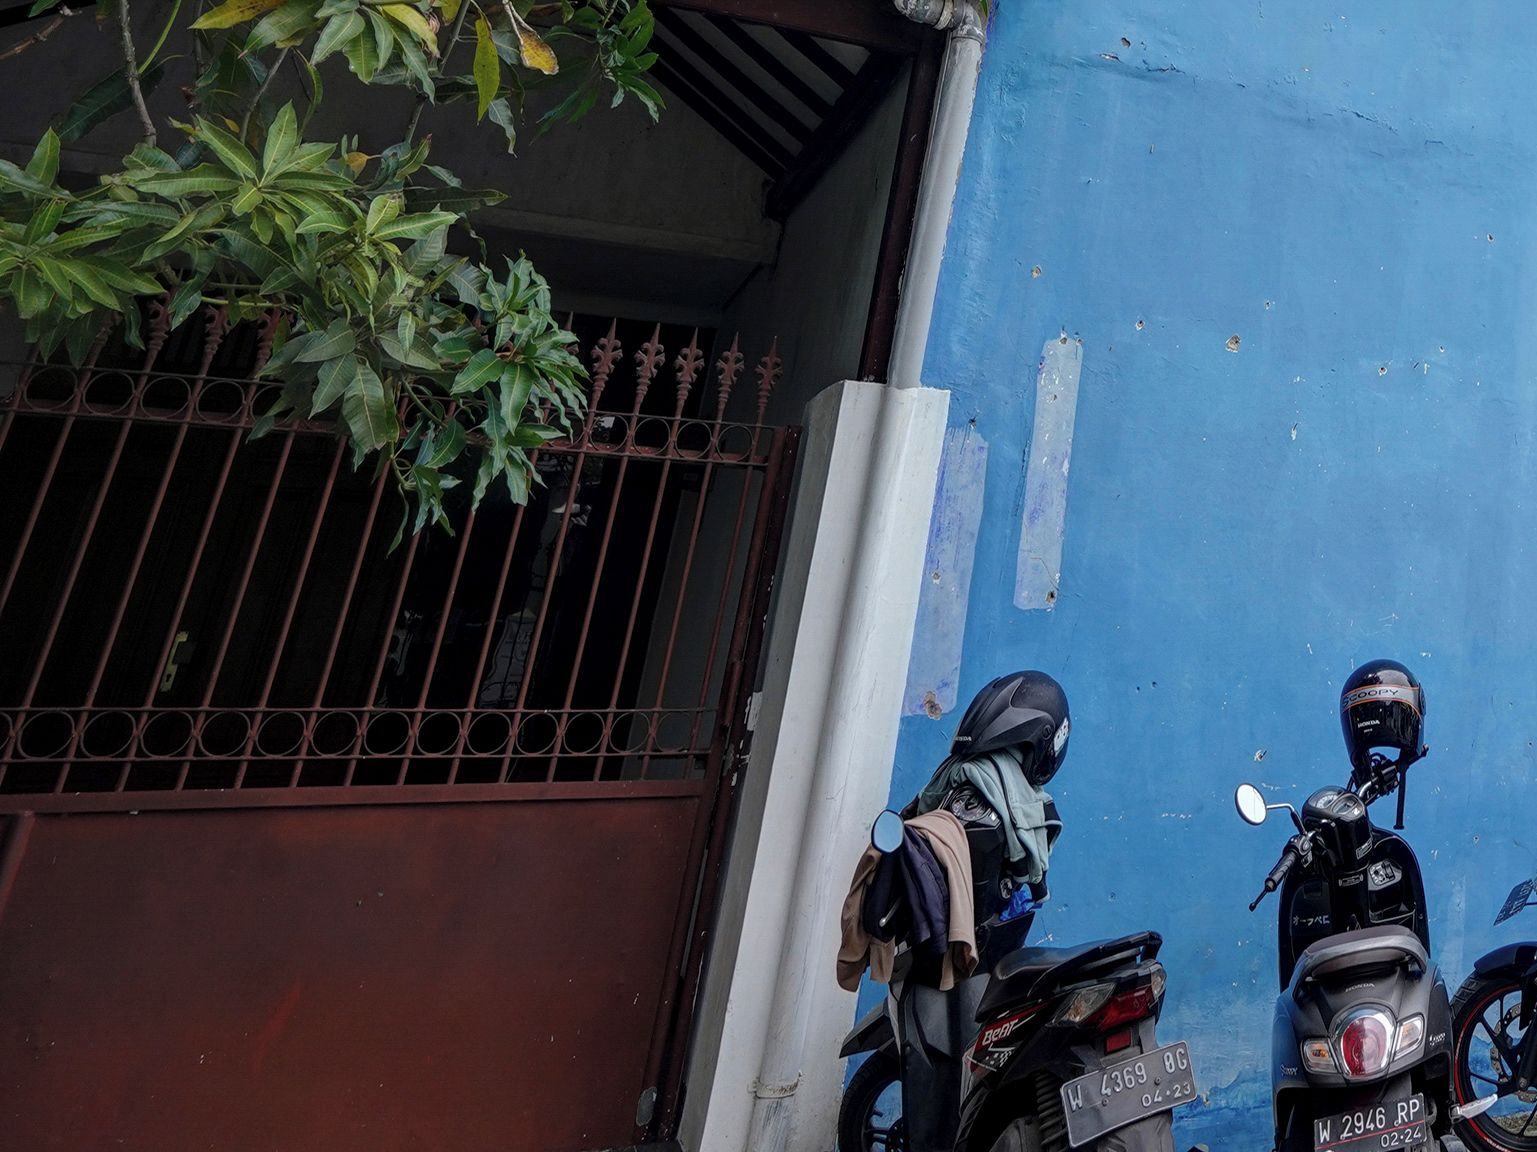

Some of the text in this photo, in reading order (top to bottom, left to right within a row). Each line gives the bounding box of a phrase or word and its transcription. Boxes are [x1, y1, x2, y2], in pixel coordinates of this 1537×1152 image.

[1357, 719, 1380, 728] HONDA
[1345, 982, 1376, 993] HONDA
[1068, 1084, 1083, 1111] W
[1101, 1062, 1147, 1096] 4369
[1319, 1099, 1421, 1144] W 2946 RP
